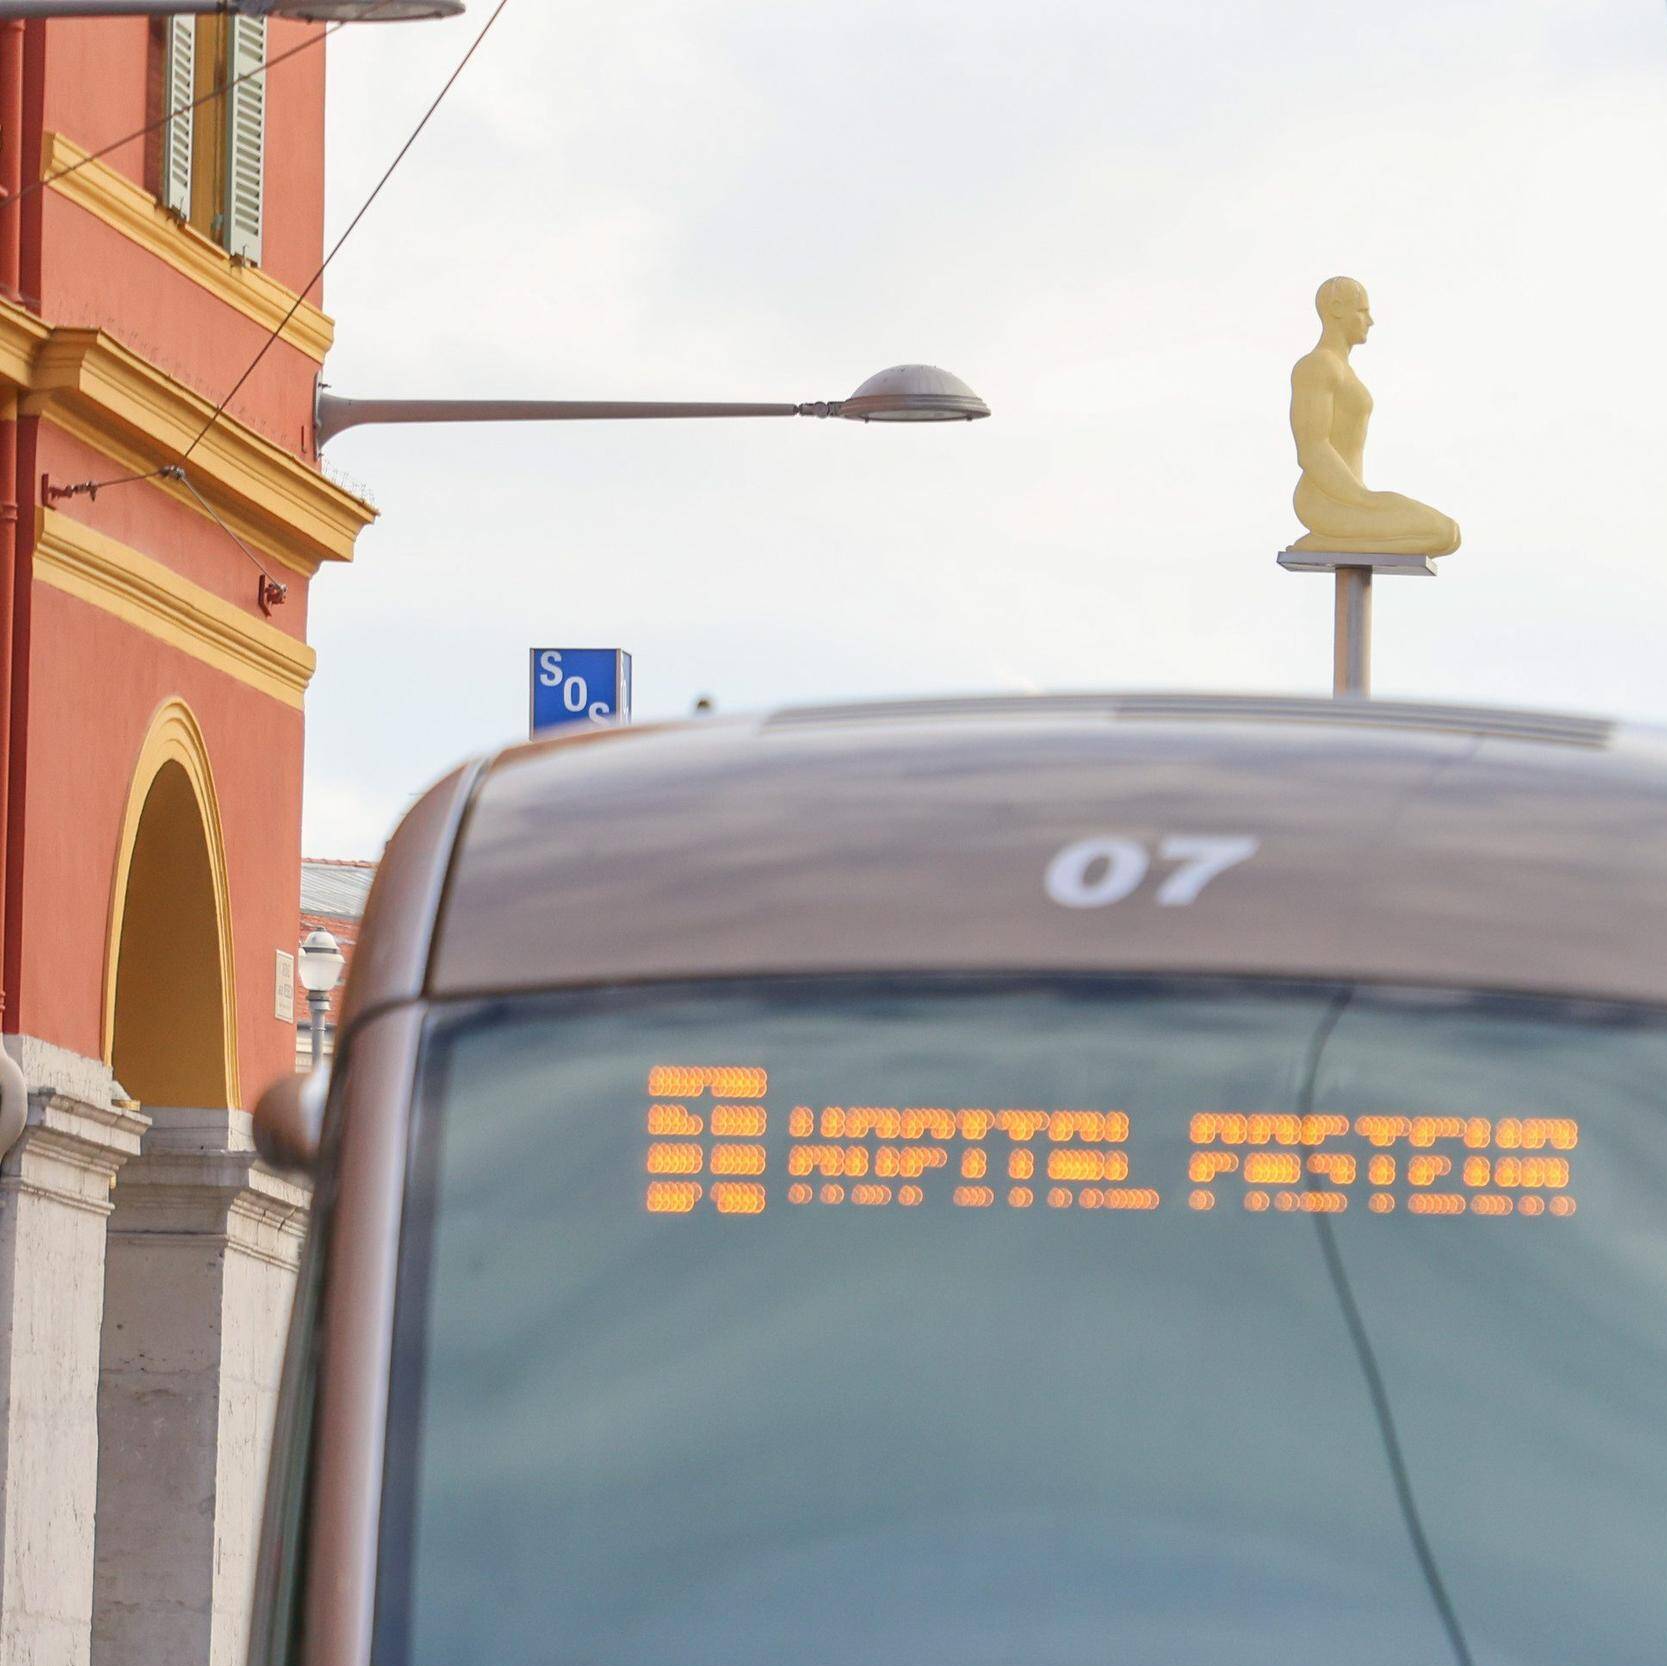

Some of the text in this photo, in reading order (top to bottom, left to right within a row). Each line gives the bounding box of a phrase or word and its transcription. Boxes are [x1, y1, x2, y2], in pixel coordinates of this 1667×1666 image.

[540, 650, 610, 727] SOS
[1044, 834, 1260, 909] 07
[1188, 1112, 1579, 1216] PASTEUR
